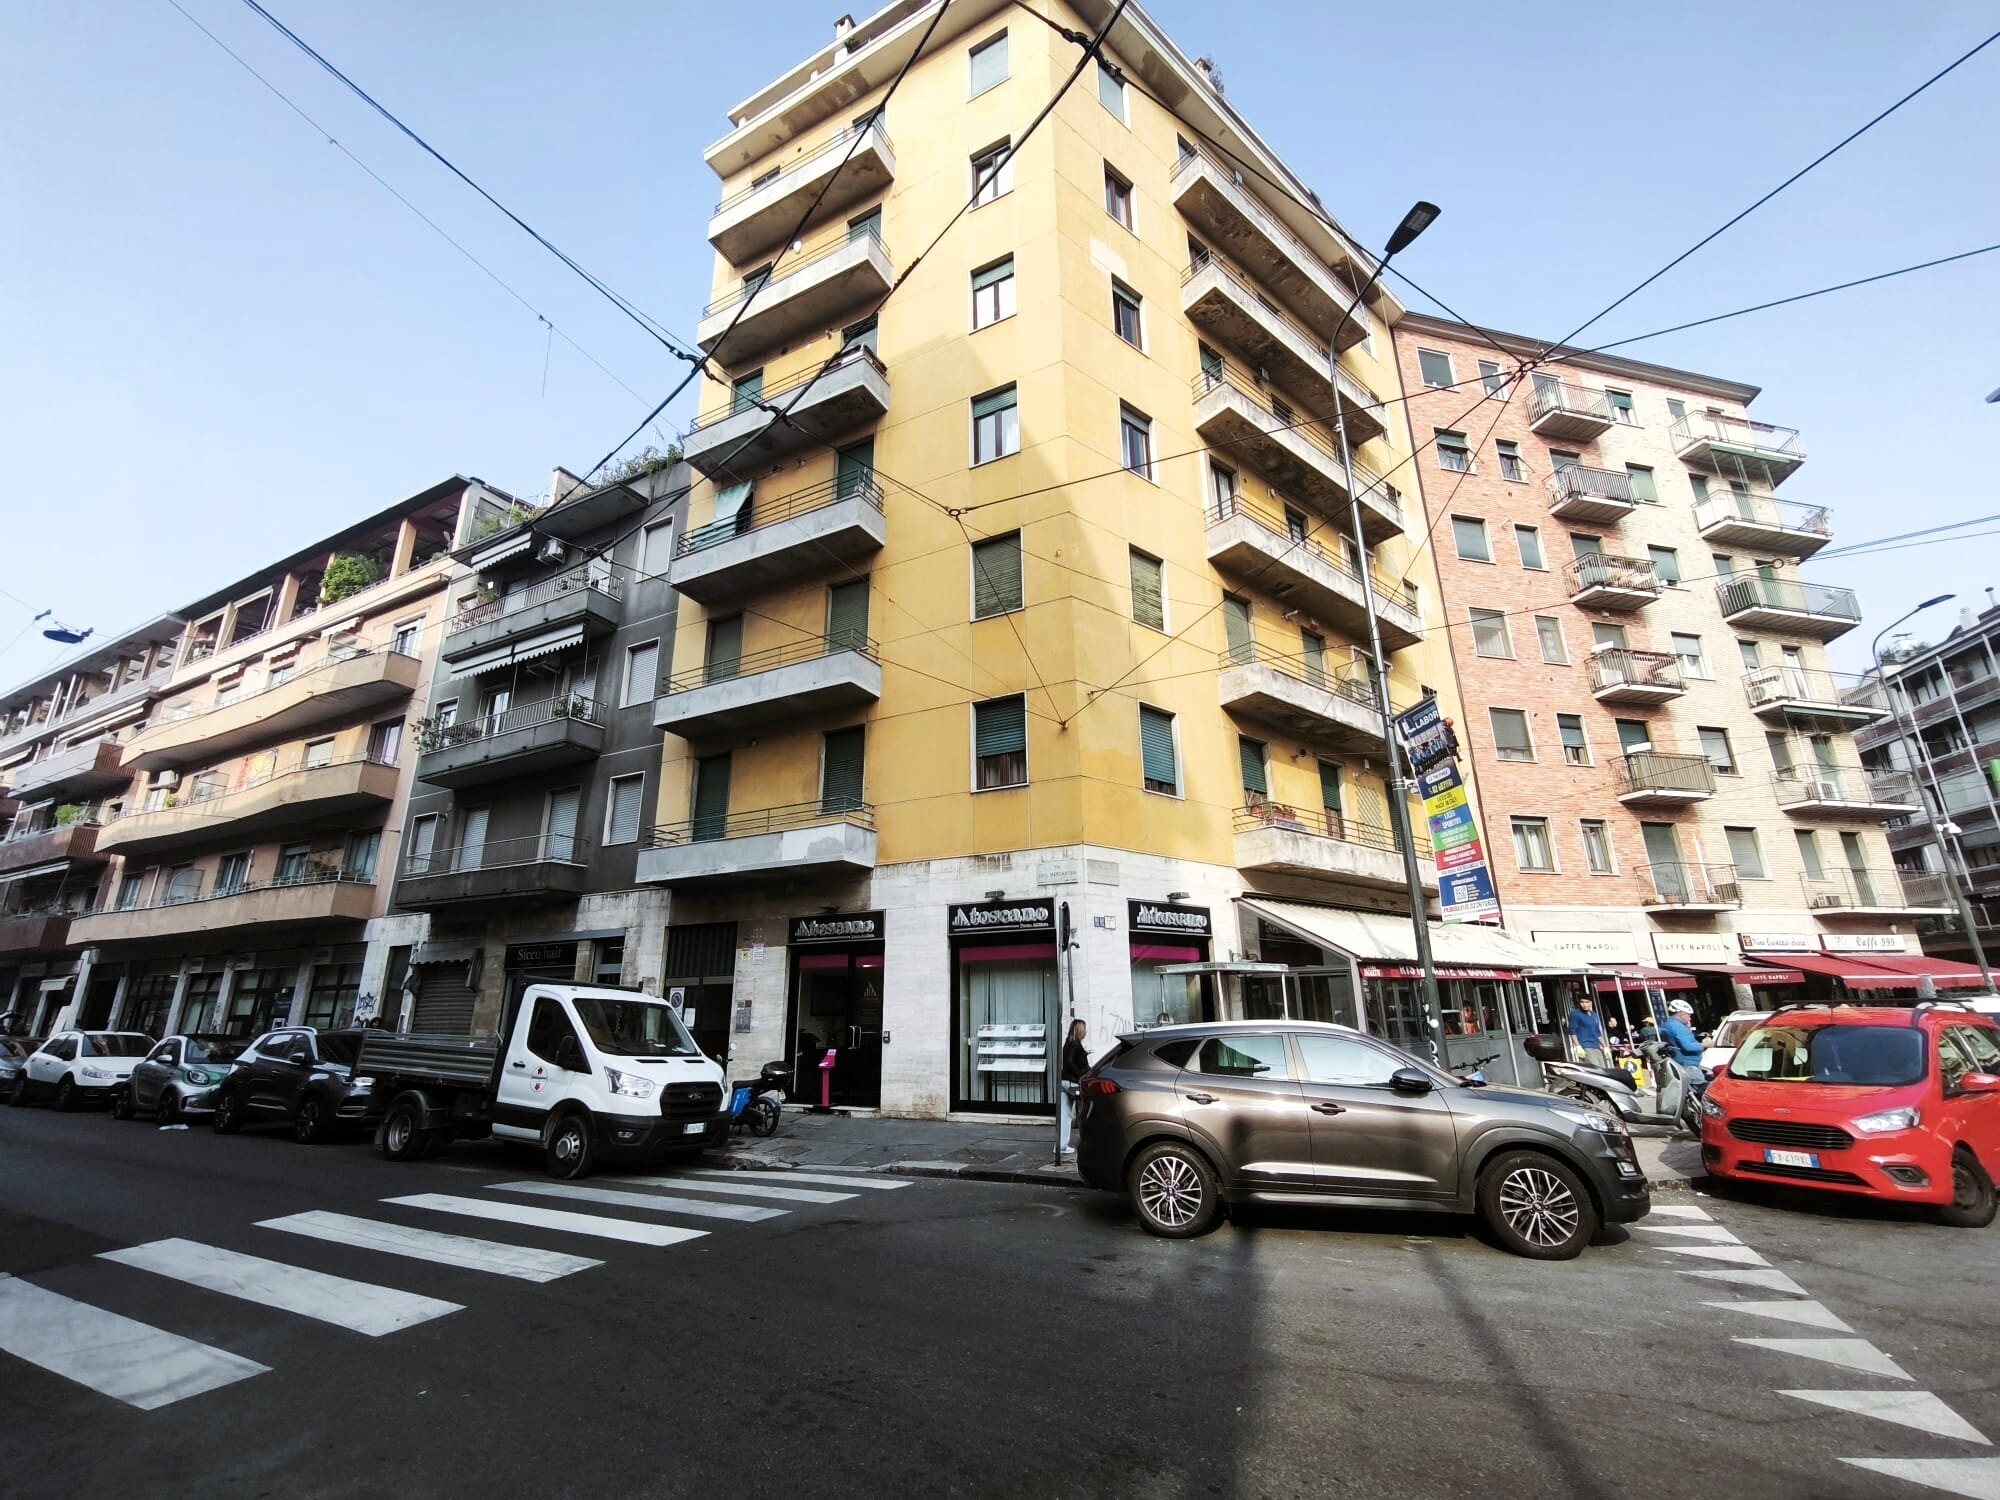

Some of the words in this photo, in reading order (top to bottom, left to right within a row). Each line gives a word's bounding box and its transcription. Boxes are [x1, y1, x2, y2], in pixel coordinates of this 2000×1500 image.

[1414, 710, 1439, 729] LABOR
[1586, 943, 1619, 951] NAPOLI
[1689, 943, 1721, 951] NAPOLI
